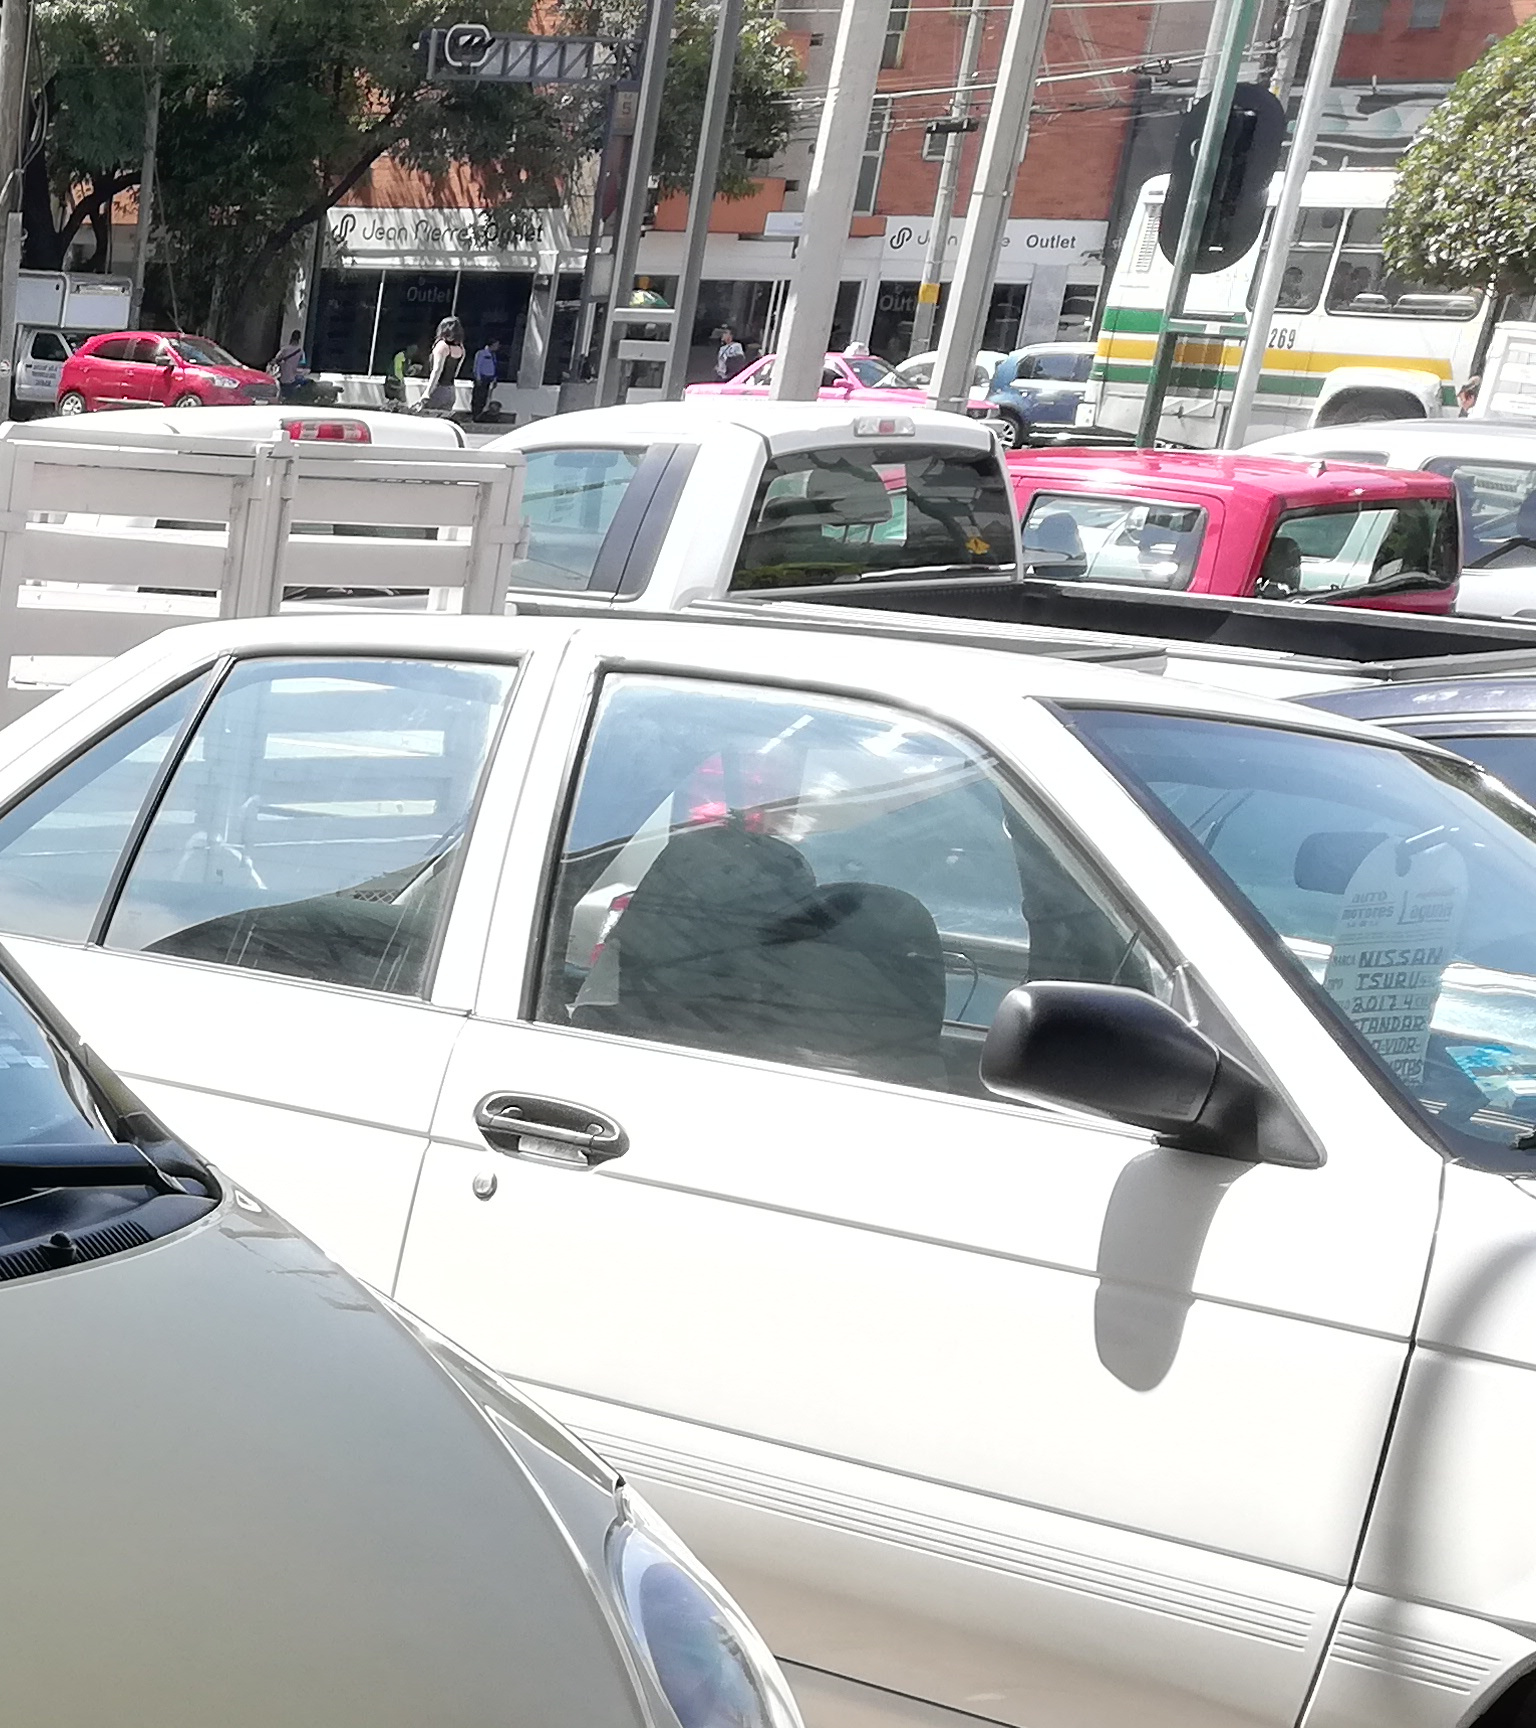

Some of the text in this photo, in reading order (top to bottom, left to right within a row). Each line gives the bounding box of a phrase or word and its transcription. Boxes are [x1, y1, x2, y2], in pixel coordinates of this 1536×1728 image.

[362, 219, 408, 241] Jean
[413, 219, 471, 241] Pierre
[1026, 234, 1076, 249] Outlet
[407, 285, 451, 303] Outlet
[1268, 328, 1296, 350] 269
[1358, 947, 1444, 968] NISSAN
[1355, 971, 1421, 991] TSURU
